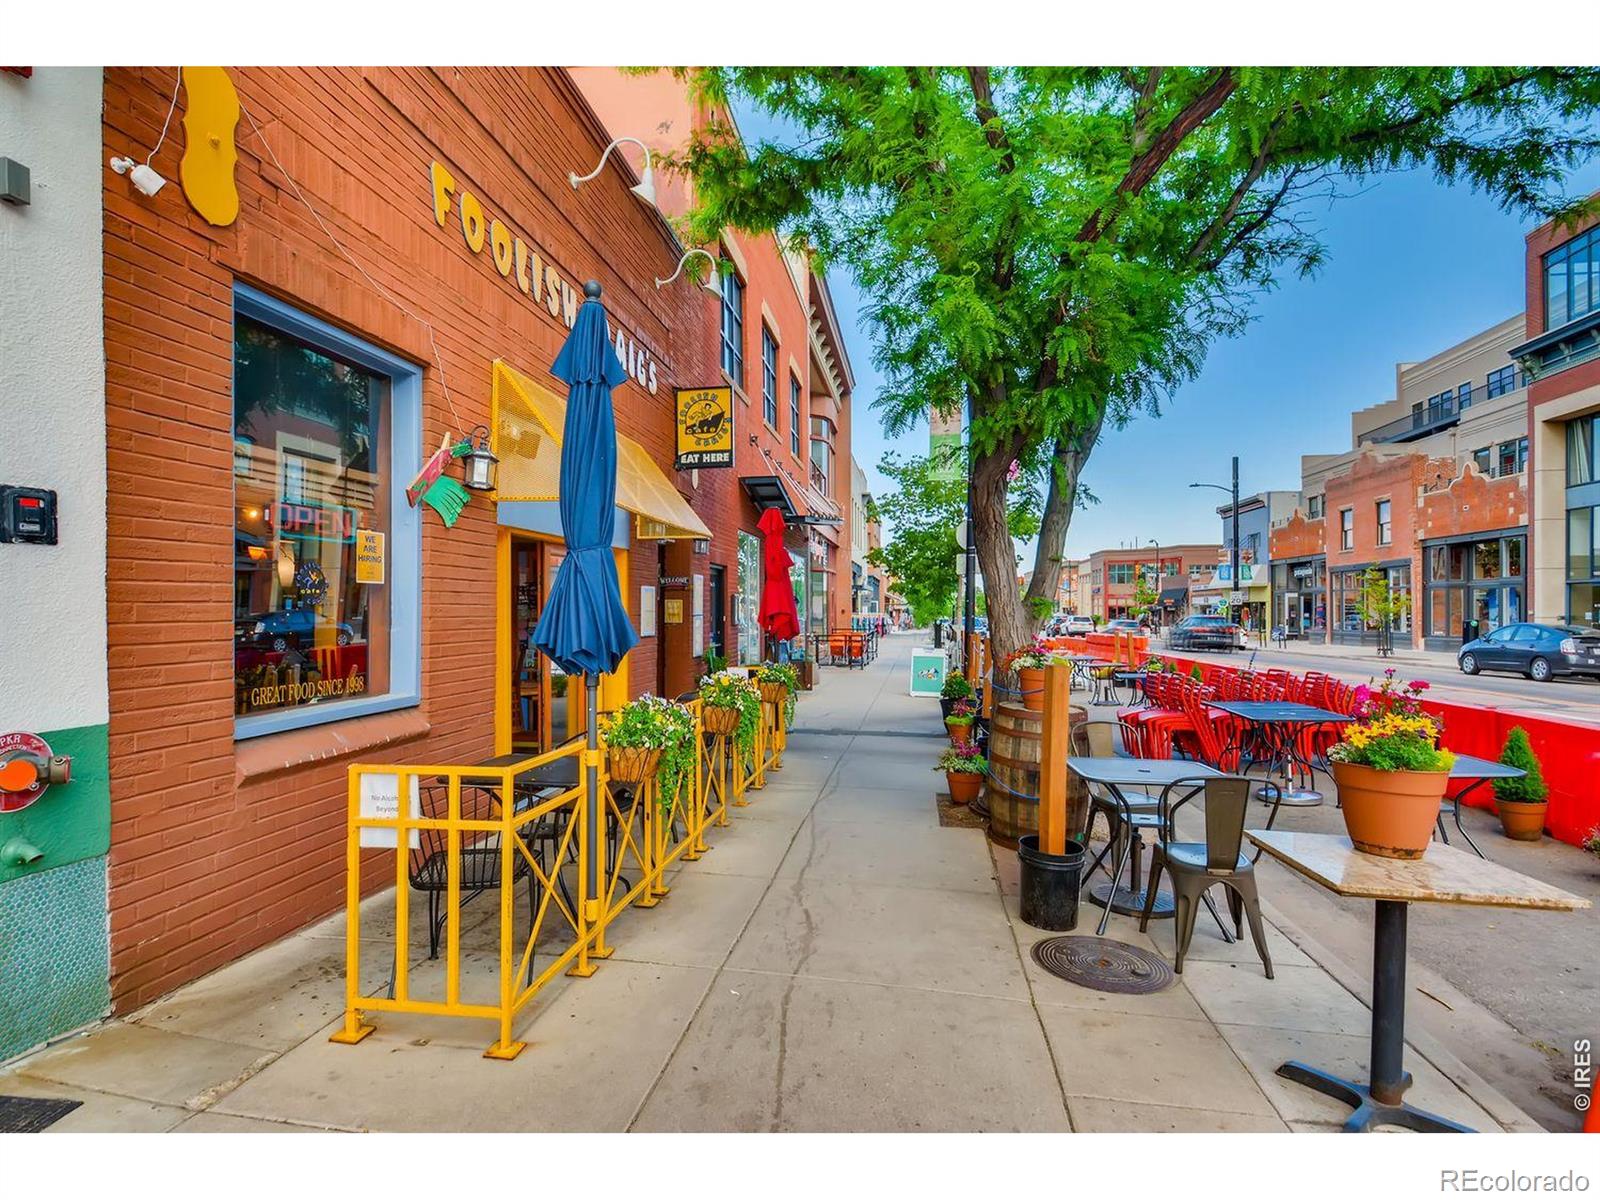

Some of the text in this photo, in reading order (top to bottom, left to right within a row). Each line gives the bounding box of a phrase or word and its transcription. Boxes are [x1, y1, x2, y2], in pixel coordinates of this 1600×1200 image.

[430, 160, 657, 395] FOOLISH AIG'S
[680, 453, 730, 464] EAT HERE
[267, 503, 352, 538] OPEN
[364, 536, 376, 544] WE
[363, 545, 377, 554] ARE
[358, 555, 382, 563] HIRING
[251, 676, 365, 706] GREAT FOOD SINCE 1998
[0, 734, 21, 746] PKR
